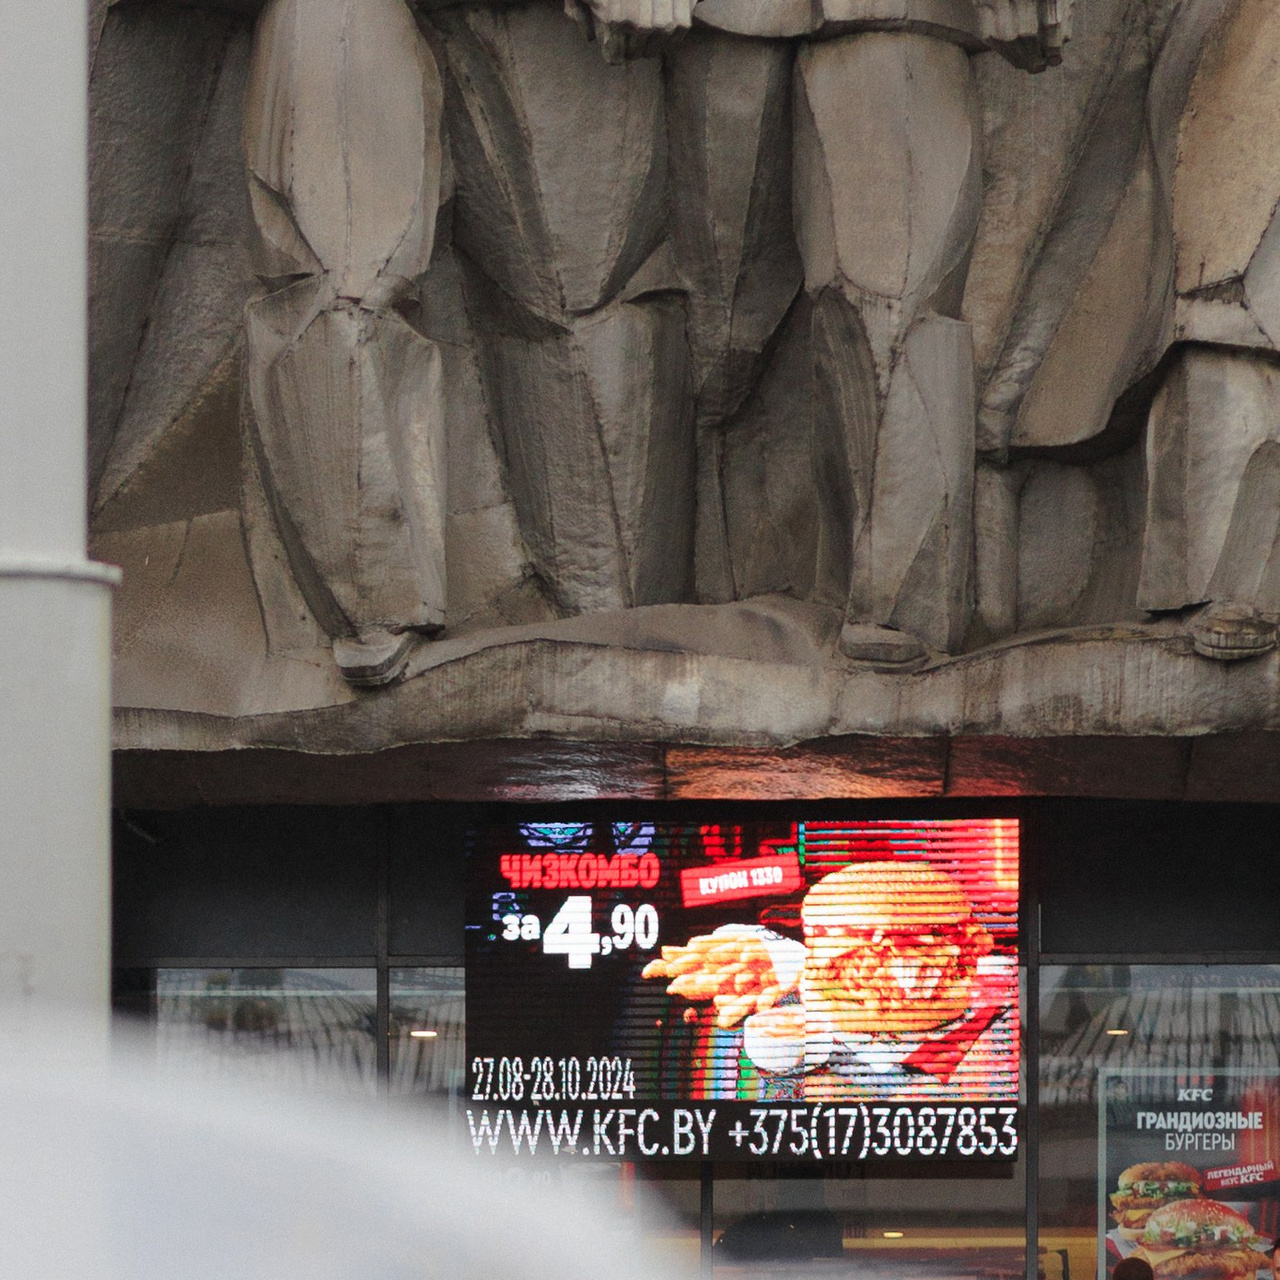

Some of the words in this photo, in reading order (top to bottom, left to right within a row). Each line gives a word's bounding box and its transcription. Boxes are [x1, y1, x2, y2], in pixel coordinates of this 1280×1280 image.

[500, 853, 661, 889] ЧИЗКОМБО
[699, 870, 749, 895] КУПОН
[502, 914, 541, 941] за
[543, 896, 659, 969] 4,90
[472, 1056, 636, 1100] 27.08-28.10.2024
[1177, 1088, 1214, 1101] KFC
[466, 1108, 717, 1155] WWW.KFC.BY
[728, 1102, 1018, 1159] +375(17)3087853
[1136, 1112, 1263, 1132] ГРАНДИОЗНЫЕ
[1165, 1133, 1235, 1150] БУРГЕРЫ
[1207, 1160, 1274, 1180] ЛЕГЕНДАРНЫЙ
[1240, 1172, 1264, 1184] KFC
